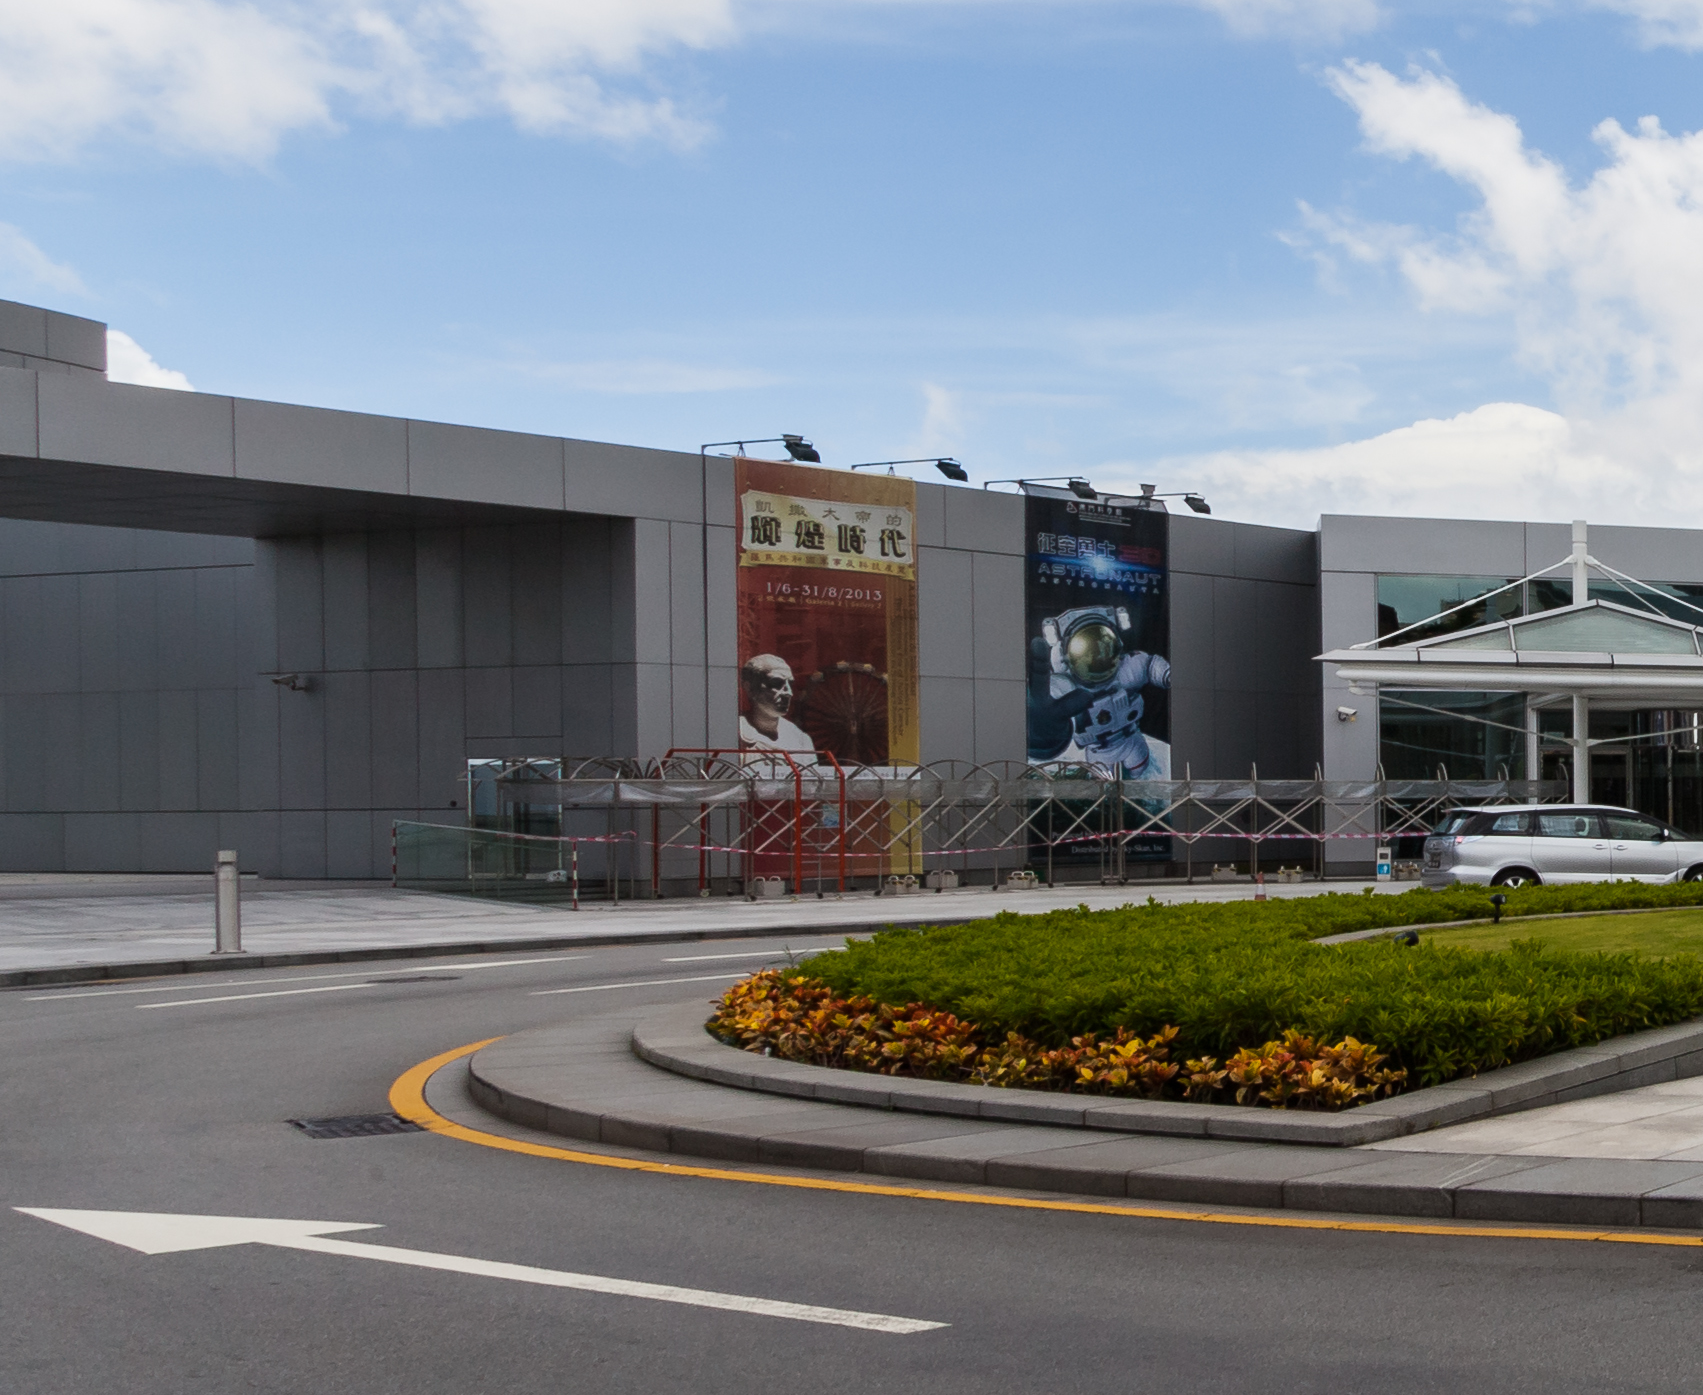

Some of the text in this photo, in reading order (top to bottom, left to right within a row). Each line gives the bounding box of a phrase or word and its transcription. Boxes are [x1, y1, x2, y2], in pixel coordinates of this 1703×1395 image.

[751, 515, 907, 557] 輝煌時代
[1038, 532, 1116, 561] 征空勇士
[1038, 562, 1162, 585] ASTRONAUT
[766, 581, 882, 601] 1/6-31/8/2013
